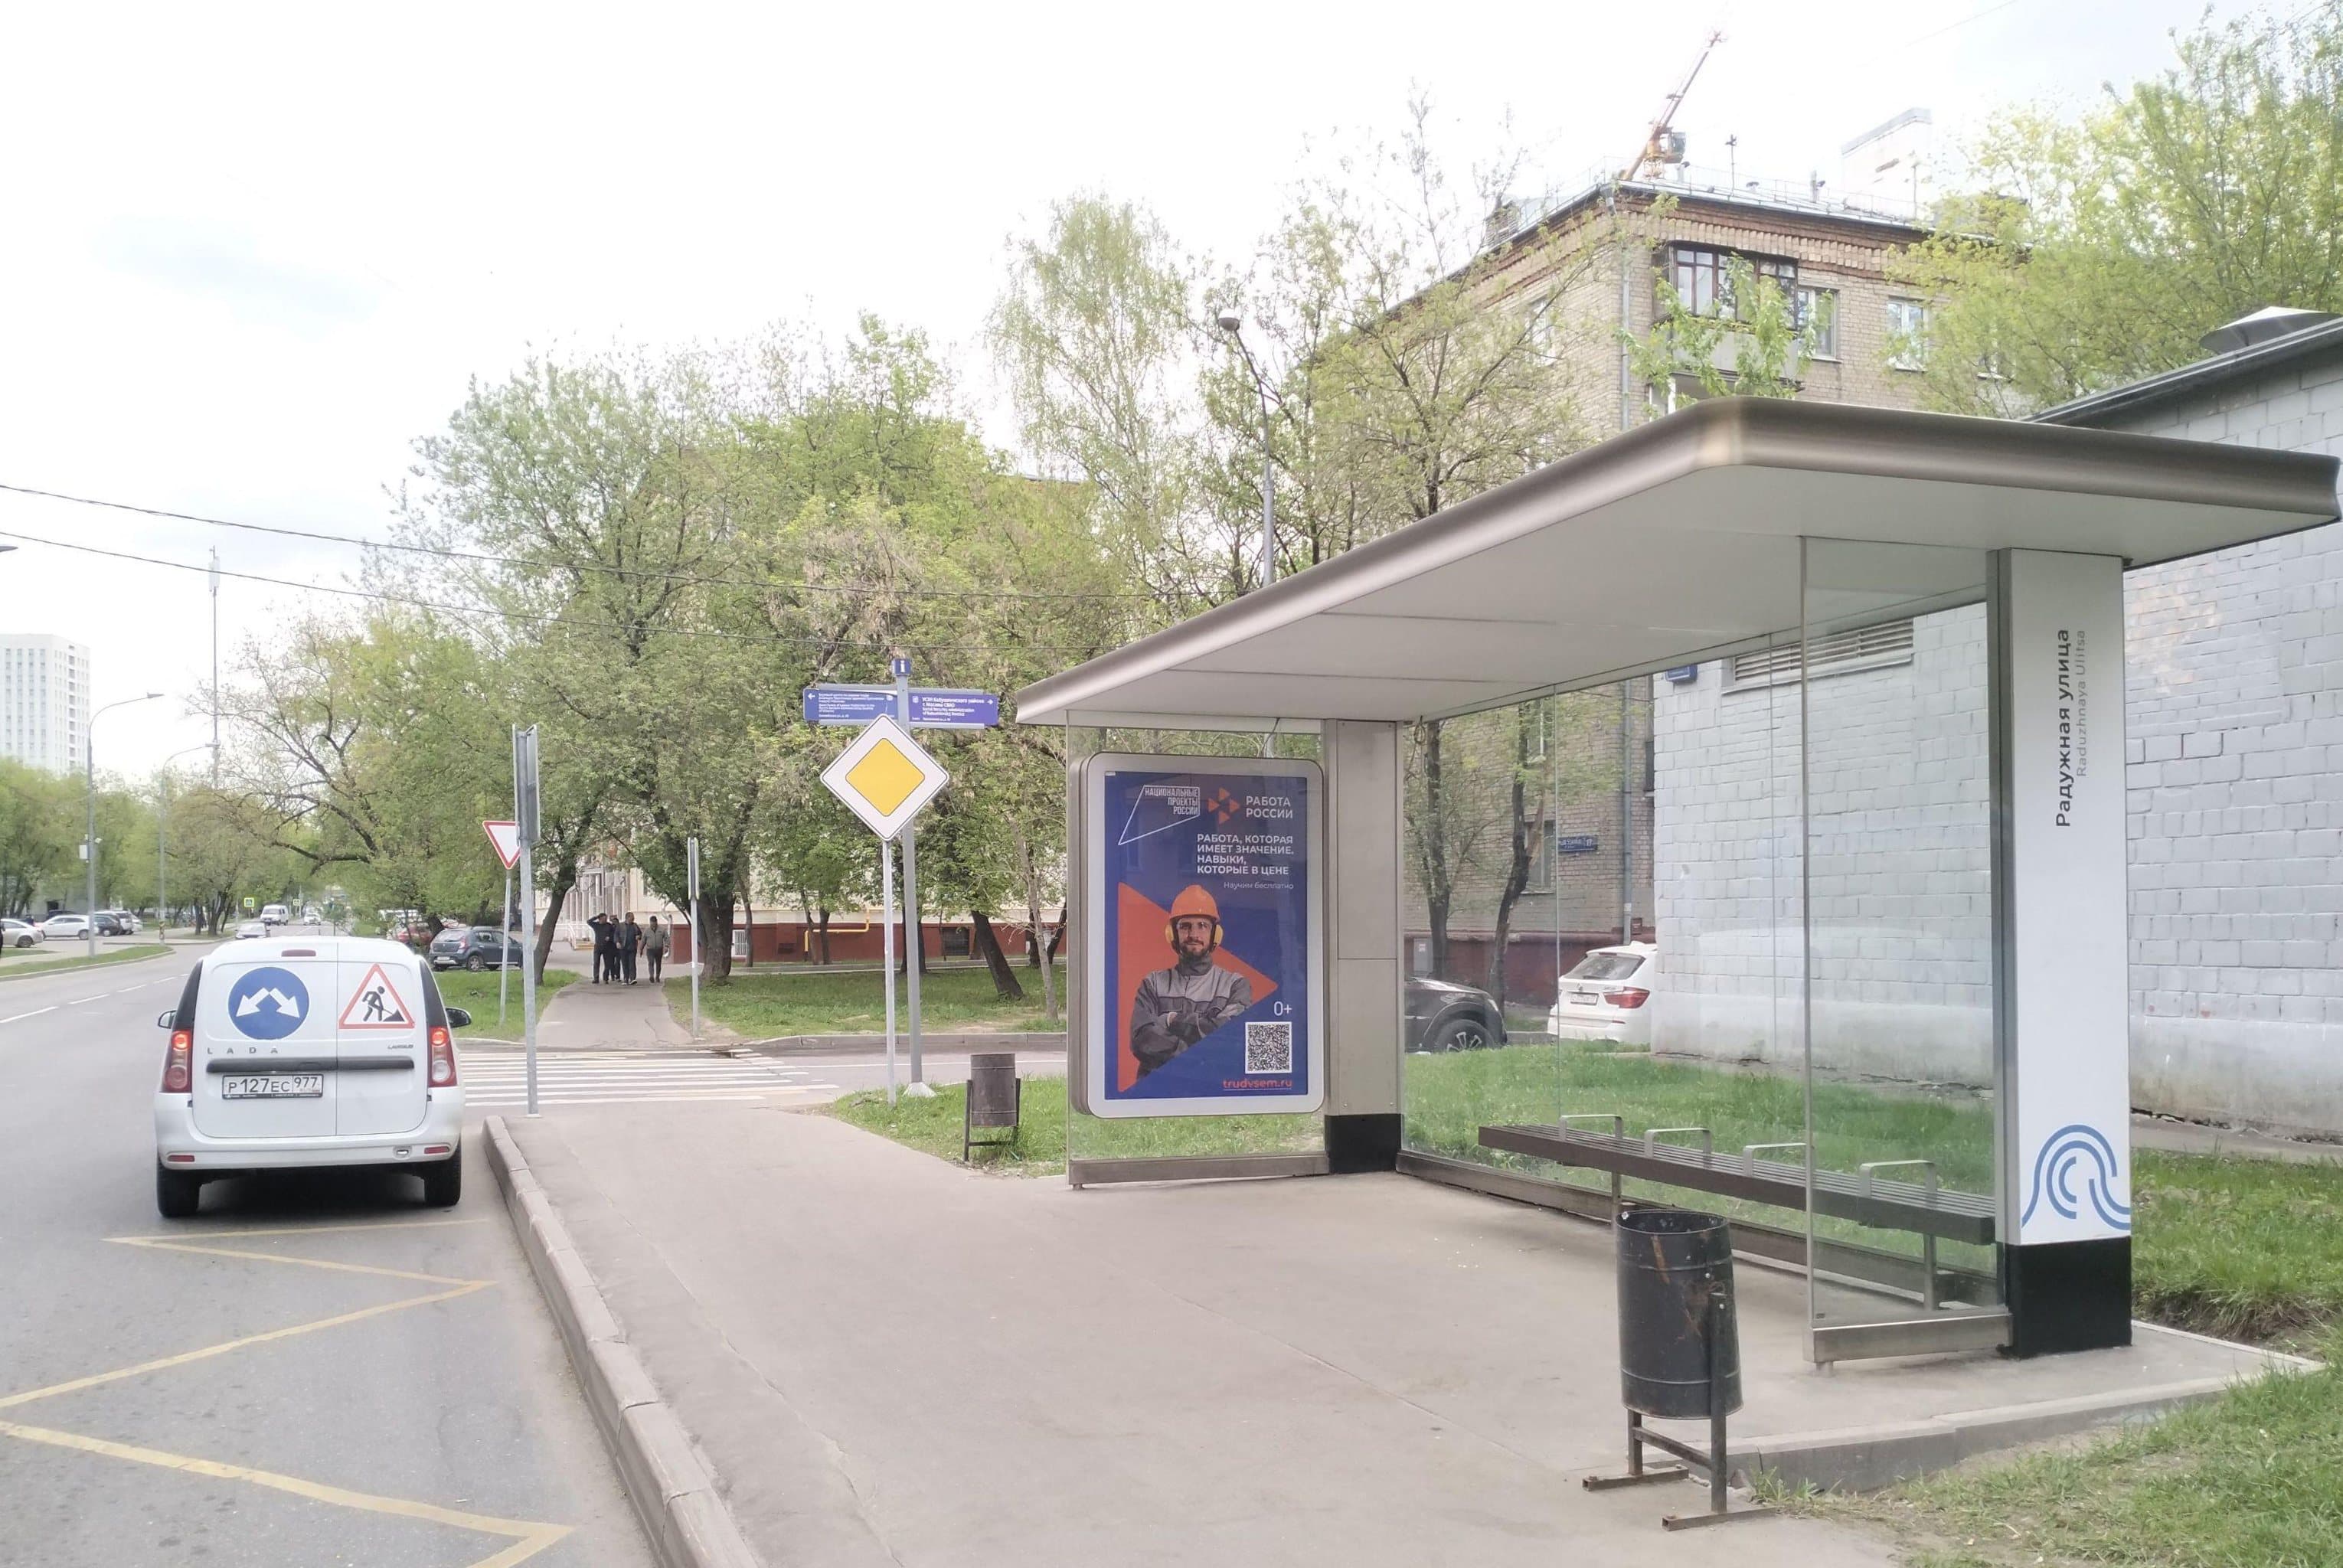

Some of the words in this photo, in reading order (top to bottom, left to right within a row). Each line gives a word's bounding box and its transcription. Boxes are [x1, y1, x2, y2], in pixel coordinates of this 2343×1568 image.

[2075, 630, 2086, 675] Ulitsa
[2057, 629, 2073, 701] улица
[2076, 681, 2088, 777] Raduzhnaya
[2056, 707, 2074, 827] Радужная
[1145, 788, 1198, 798] НАЦИОНАЛЬНЫЕ
[1168, 797, 1198, 805] ПРОЕКТЫ
[1246, 795, 1291, 807] РАБОТА
[1173, 806, 1198, 815] РОССИИ
[1246, 808, 1293, 818] РОССИИ
[1197, 835, 1243, 844] РАБОТА,
[1245, 835, 1293, 844] КОТОРАЯ
[1197, 844, 1233, 854] ИМЕЕТ
[1235, 845, 1294, 854] ЗНАЧЕНИЕ.
[1197, 855, 1247, 865] НАВЫКИ,
[1197, 866, 1249, 875] КОТОРЫЕ
[1252, 866, 1258, 874] В
[1260, 867, 1289, 876] ЦЕНЕ
[1224, 881, 1253, 890] Научим
[1254, 881, 1294, 890] бесплатно
[1273, 1001, 1292, 1016] 0+
[207, 1047, 278, 1055] LADA
[294, 1076, 318, 1088] 977
[1223, 1079, 1292, 1089] trudvsem.ru
